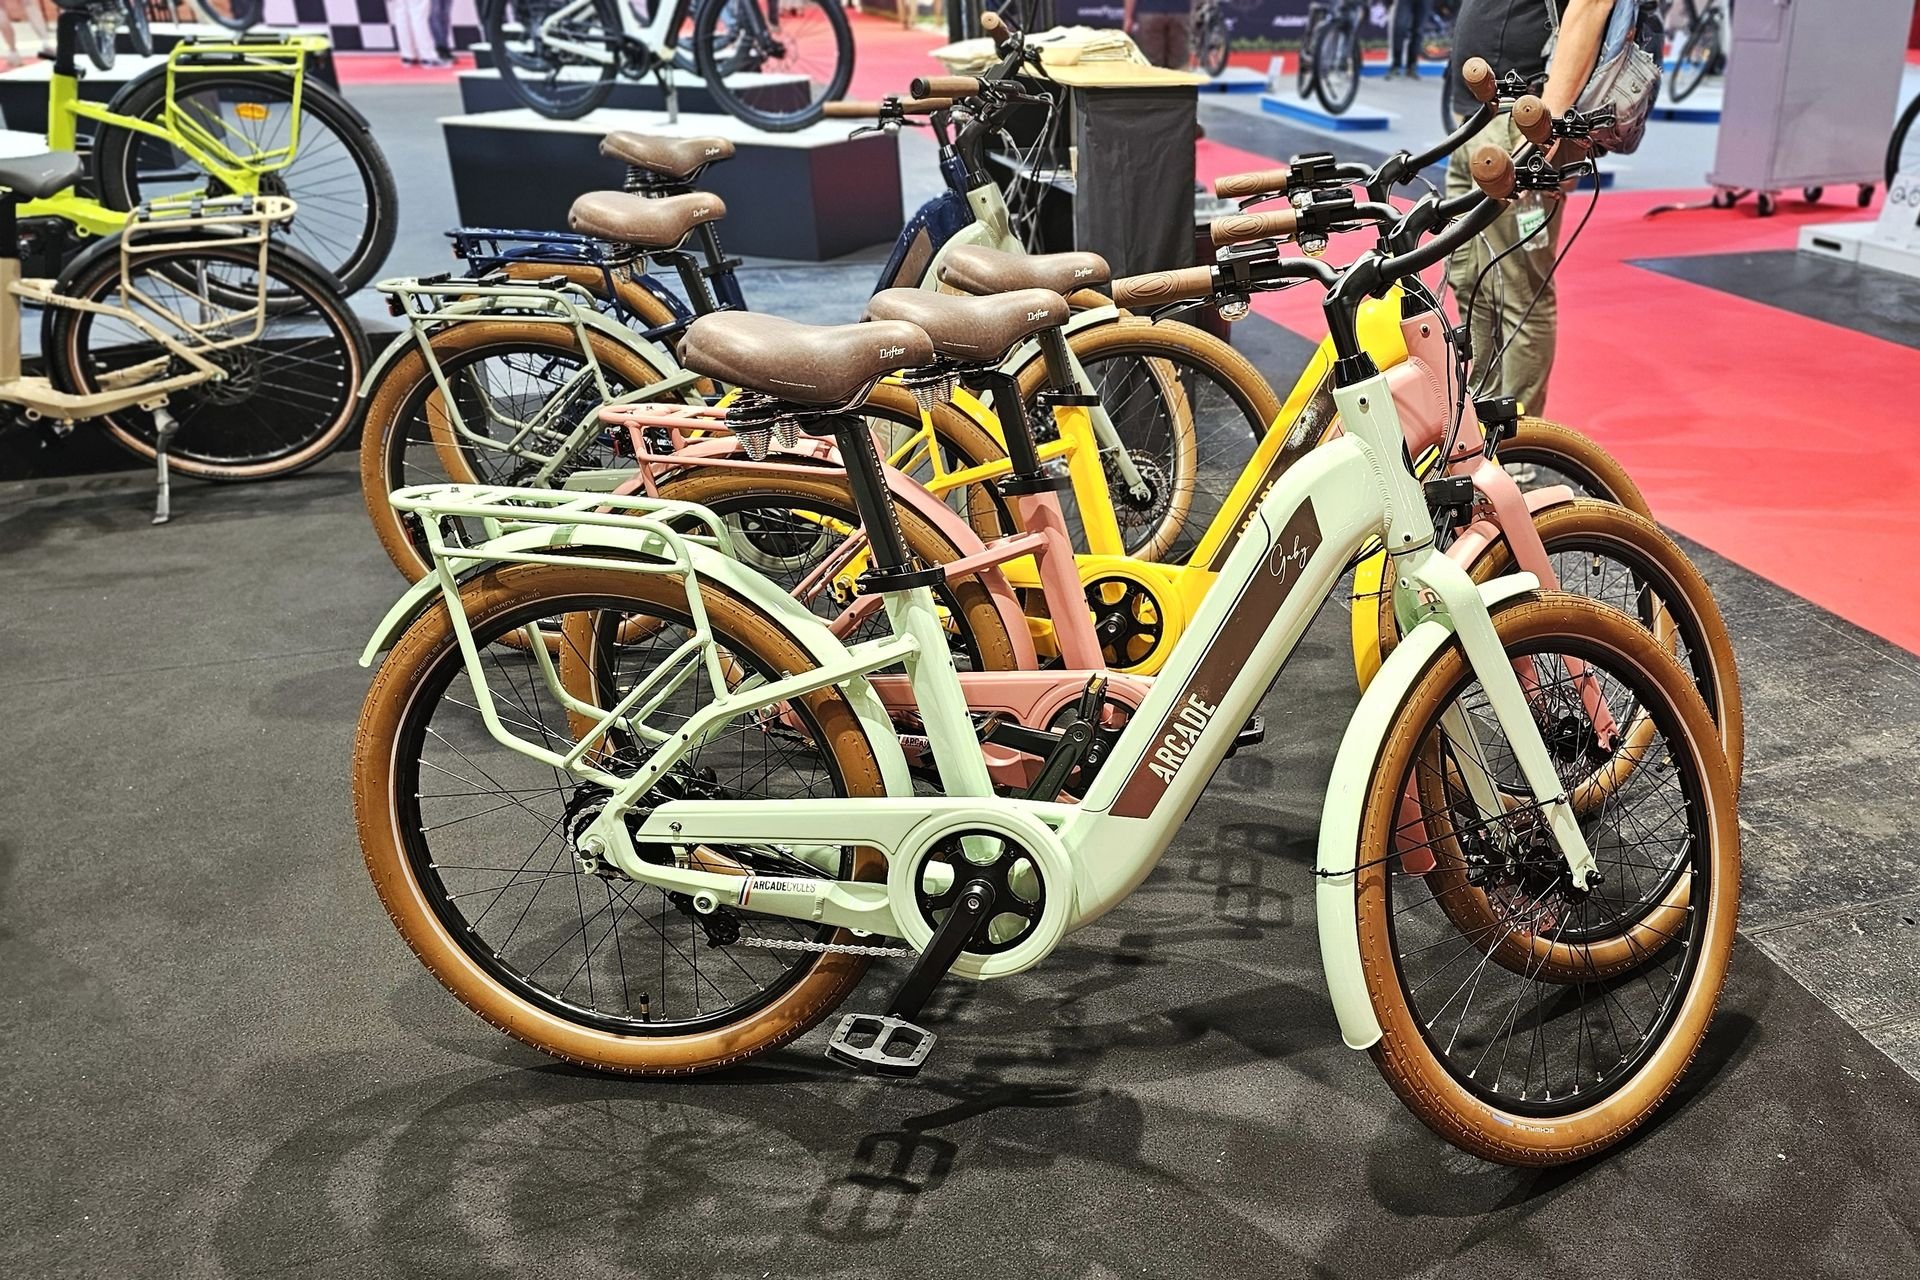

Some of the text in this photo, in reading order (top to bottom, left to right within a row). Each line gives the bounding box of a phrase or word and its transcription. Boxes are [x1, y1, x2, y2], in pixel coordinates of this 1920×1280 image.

[1026, 308, 1049, 321] Drifter
[879, 345, 906, 359] Drifter
[1269, 535, 1310, 585] Gaby
[1148, 692, 1217, 785] ARCADE
